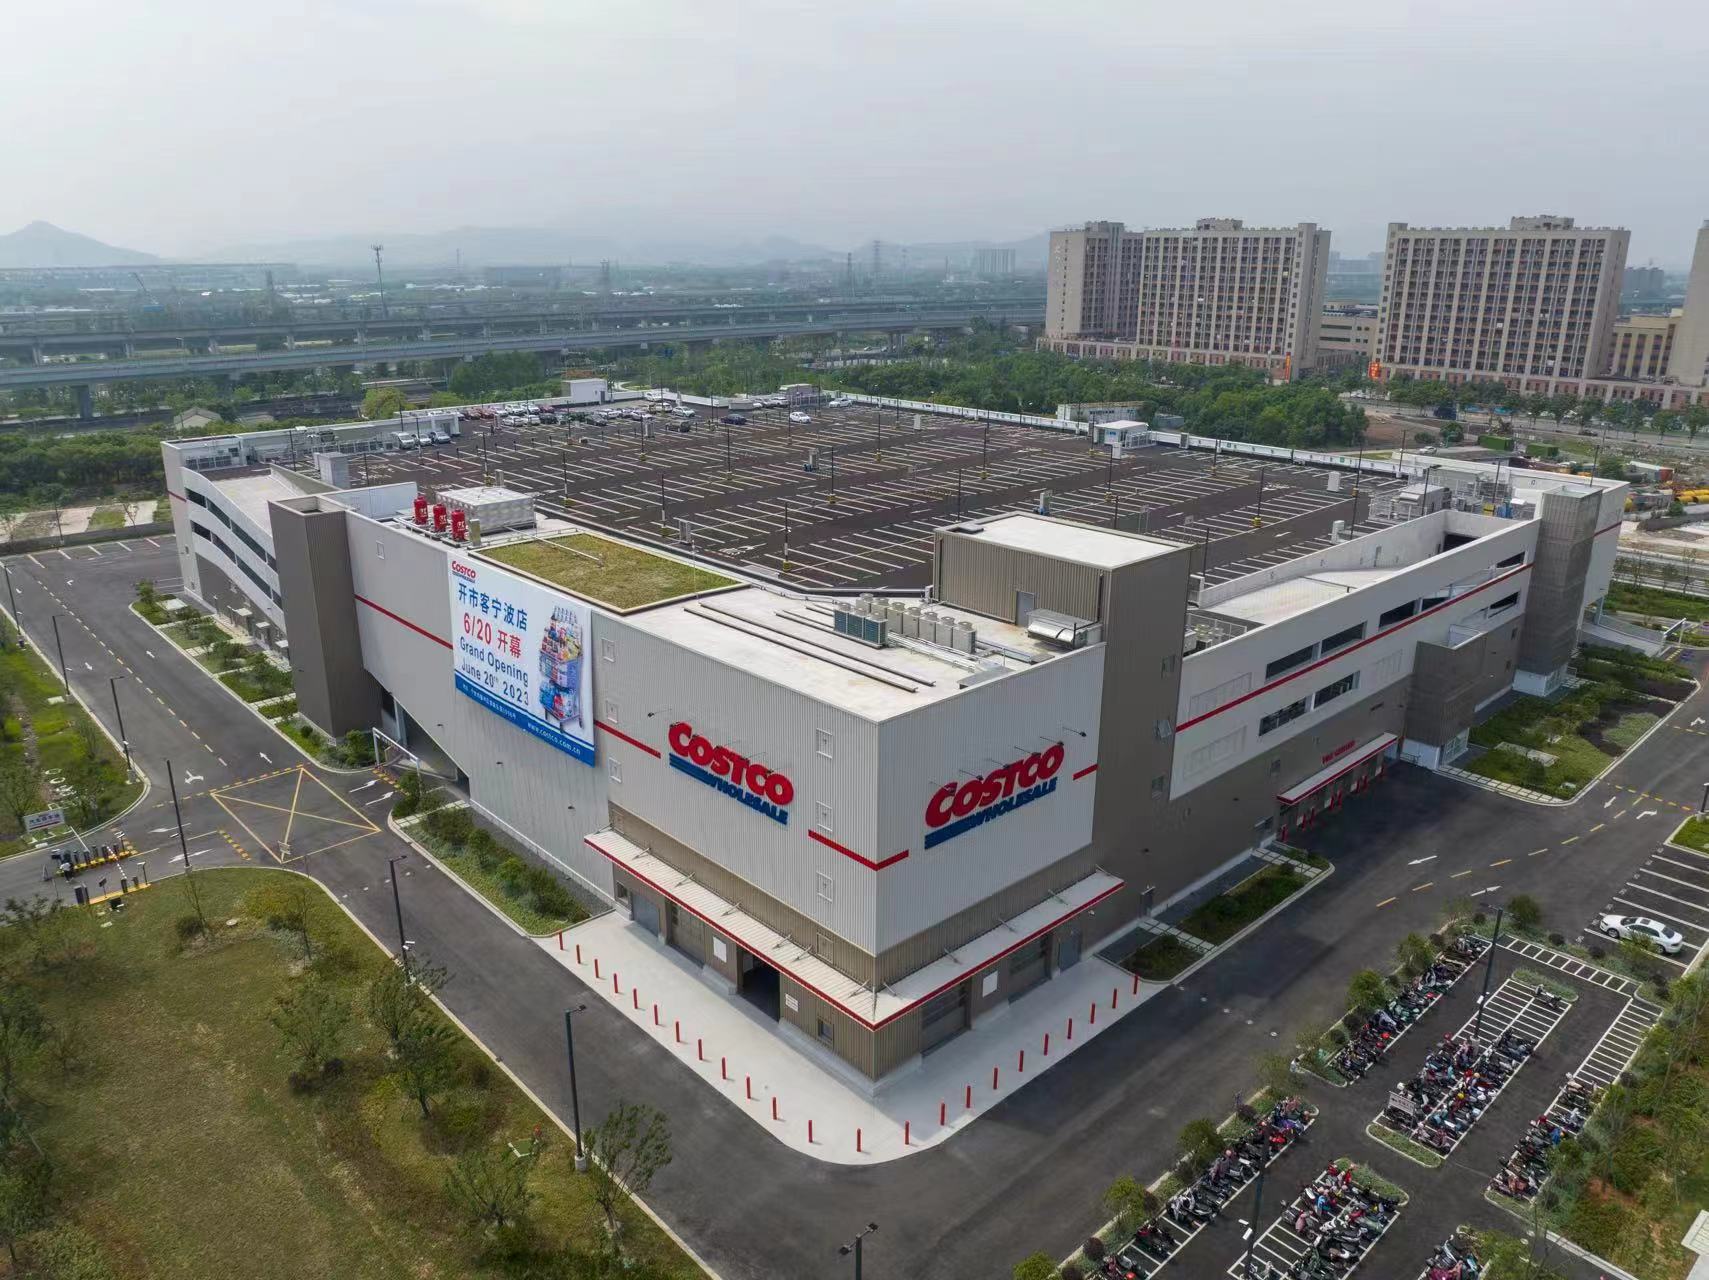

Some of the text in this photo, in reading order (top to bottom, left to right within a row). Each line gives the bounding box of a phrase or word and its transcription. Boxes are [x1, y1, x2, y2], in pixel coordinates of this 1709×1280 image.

[451, 560, 476, 579] COSTCO
[458, 582, 528, 632] 开市客宁波店
[463, 612, 522, 659] 6/20 开幕
[459, 636, 529, 687] Grand Opening
[461, 659, 482, 682] June
[503, 681, 529, 706] 2023
[668, 721, 794, 806] COSTCO
[924, 743, 1065, 828] COSTCO
[706, 773, 789, 826] WHOLESALE
[968, 775, 1058, 831] WHOLESALE
